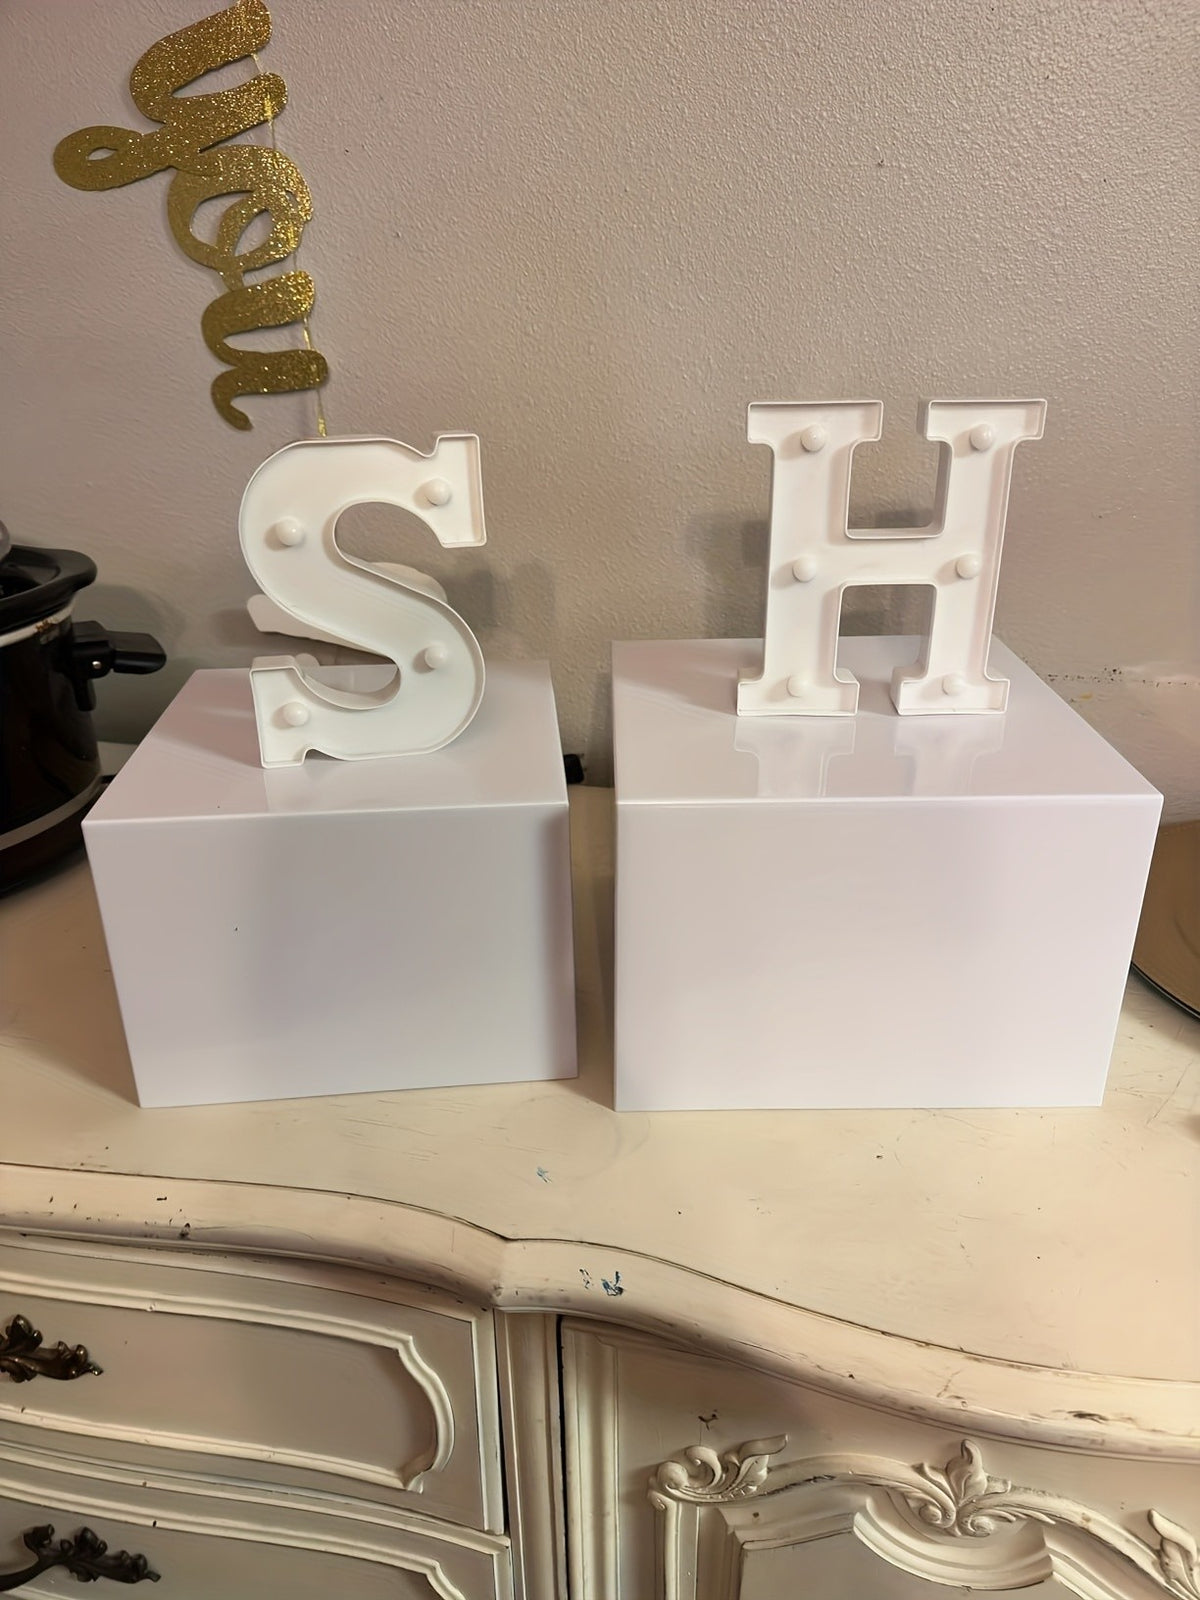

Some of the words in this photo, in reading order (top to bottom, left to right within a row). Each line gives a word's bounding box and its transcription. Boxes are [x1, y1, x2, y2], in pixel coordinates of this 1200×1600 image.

[53, 0, 328, 430] you
[238, 433, 487, 769] S
[737, 398, 1048, 717] H
